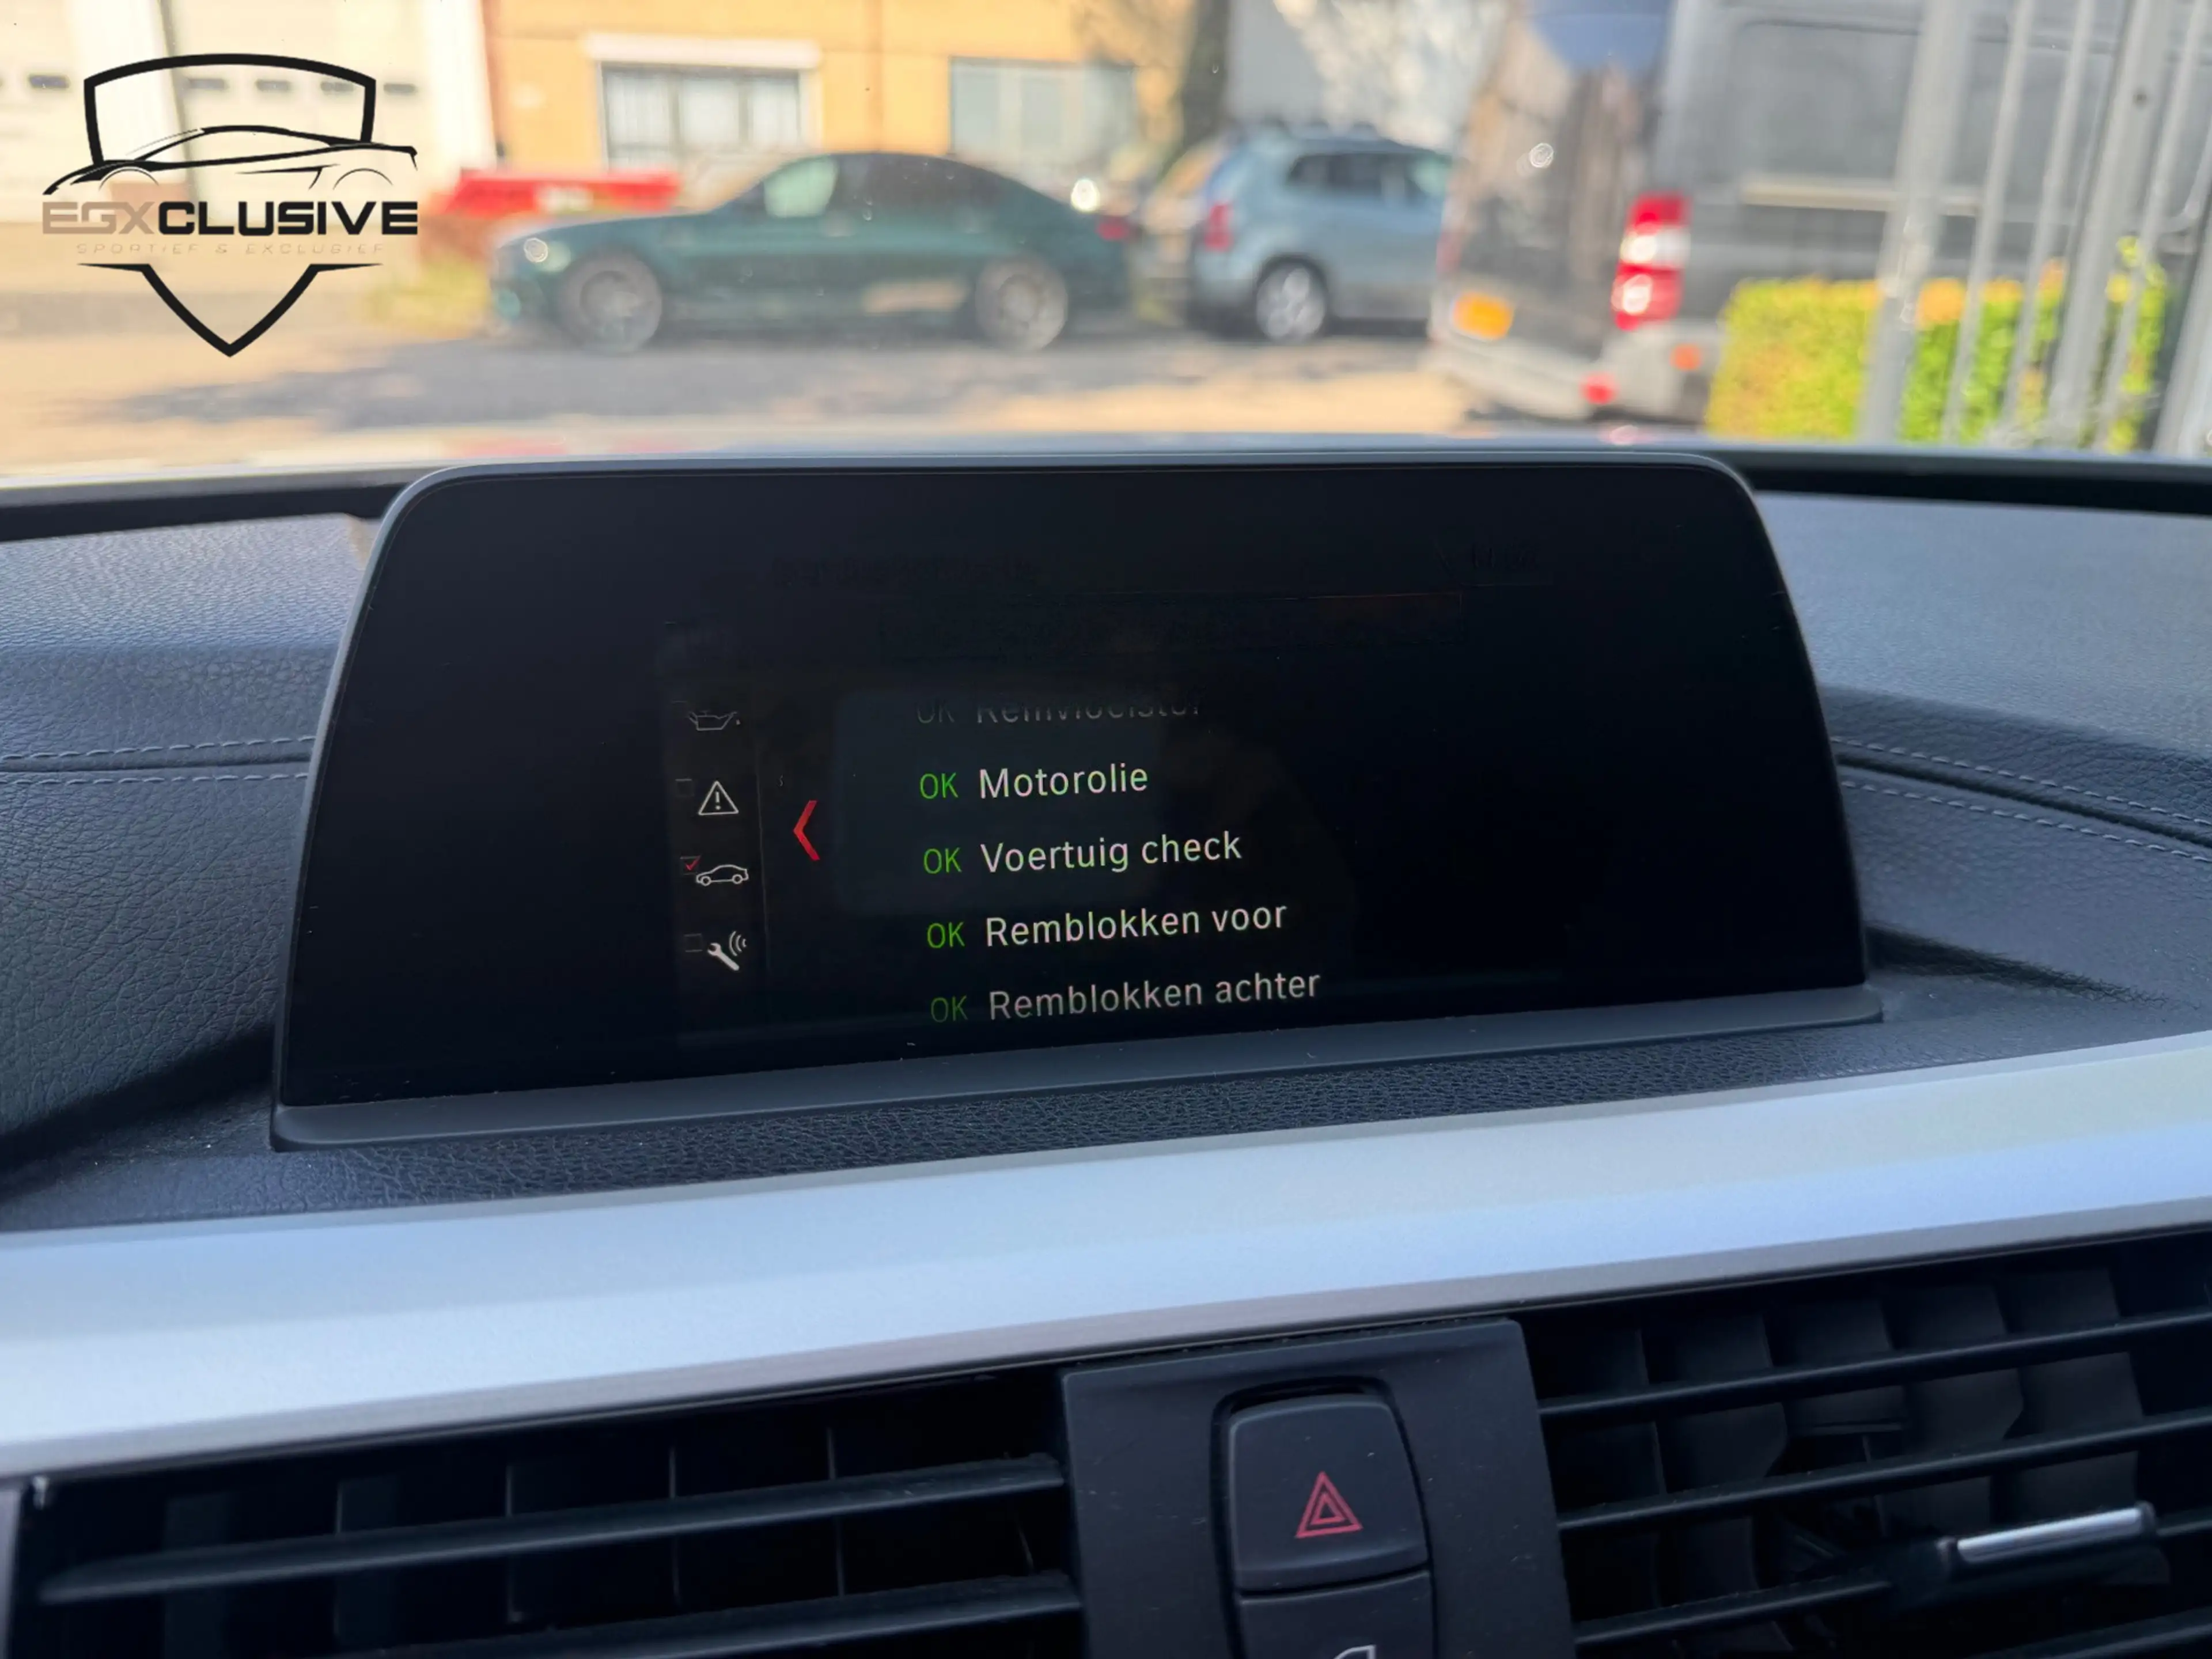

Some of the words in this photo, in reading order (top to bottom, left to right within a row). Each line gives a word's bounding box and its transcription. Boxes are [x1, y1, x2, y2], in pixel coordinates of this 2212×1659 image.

[919, 772, 959, 800] OK
[979, 762, 1148, 800] Motorolie
[923, 847, 962, 874] OK
[980, 836, 1129, 873] Voertuig
[1141, 830, 1242, 864] check
[926, 922, 965, 948] OK
[986, 907, 1200, 947] Remblokken
[1211, 905, 1287, 933] voor
[930, 995, 968, 1023] OK
[989, 979, 1203, 1021] Remblokken
[1215, 971, 1321, 1003] achter
